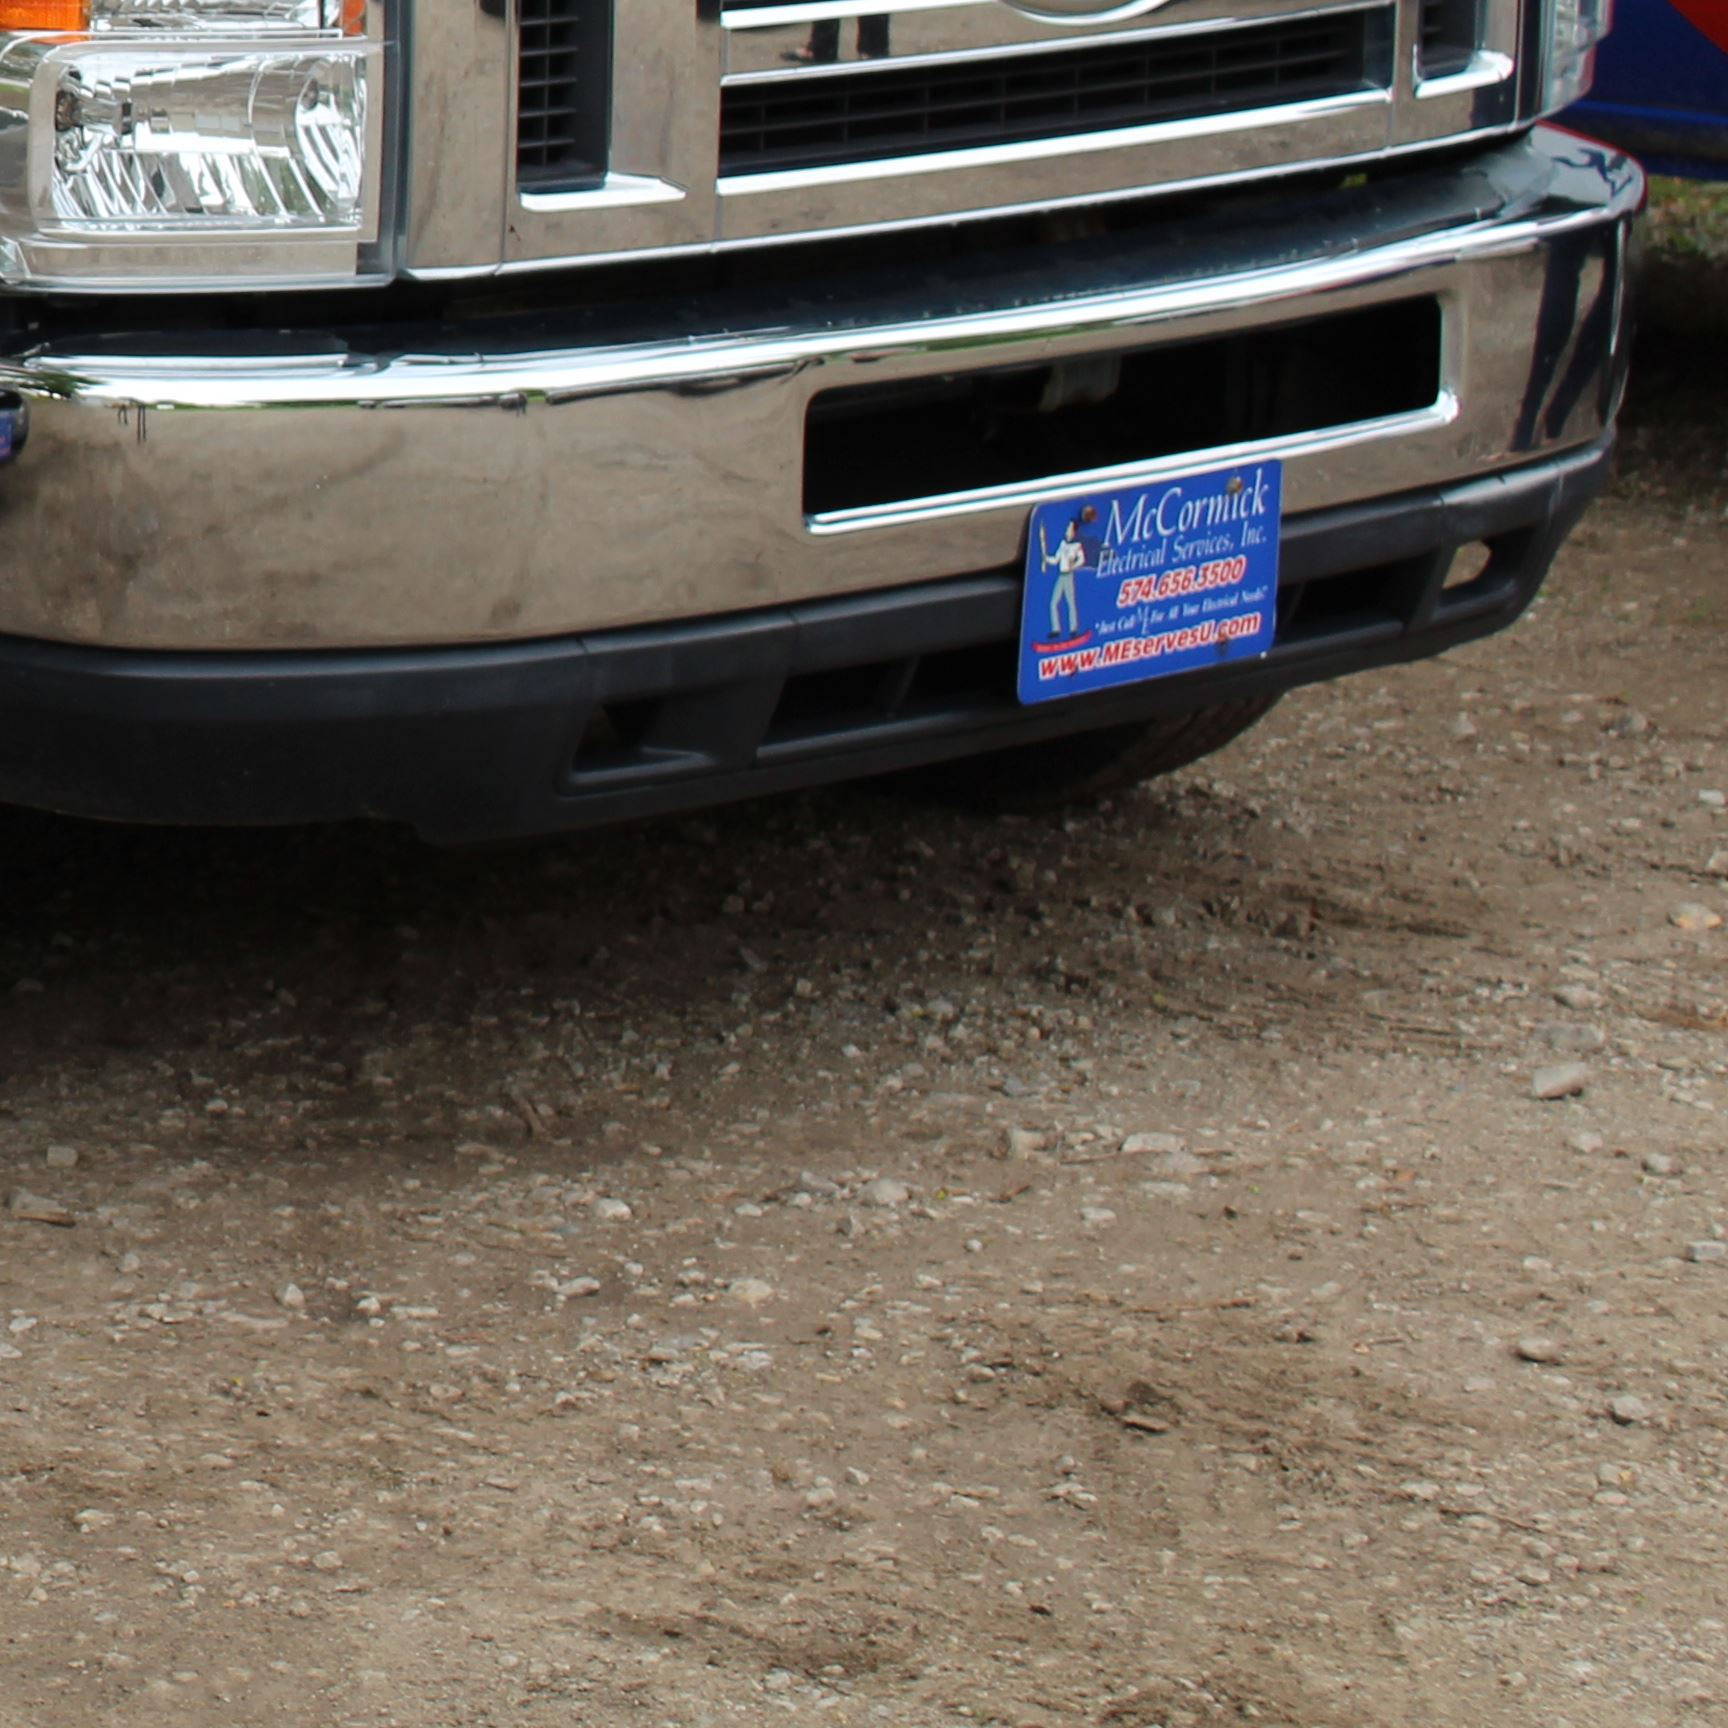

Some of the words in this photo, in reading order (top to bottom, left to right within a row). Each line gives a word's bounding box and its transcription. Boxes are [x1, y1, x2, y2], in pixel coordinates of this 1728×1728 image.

[1102, 468, 1270, 548] McCormick
[1095, 537, 1168, 579] Electrical
[1171, 528, 1235, 563] Services,
[1241, 519, 1267, 547] Inc.
[1116, 554, 1248, 609] 574.656.3500
[1037, 612, 1262, 681] www.MEservesU.com
